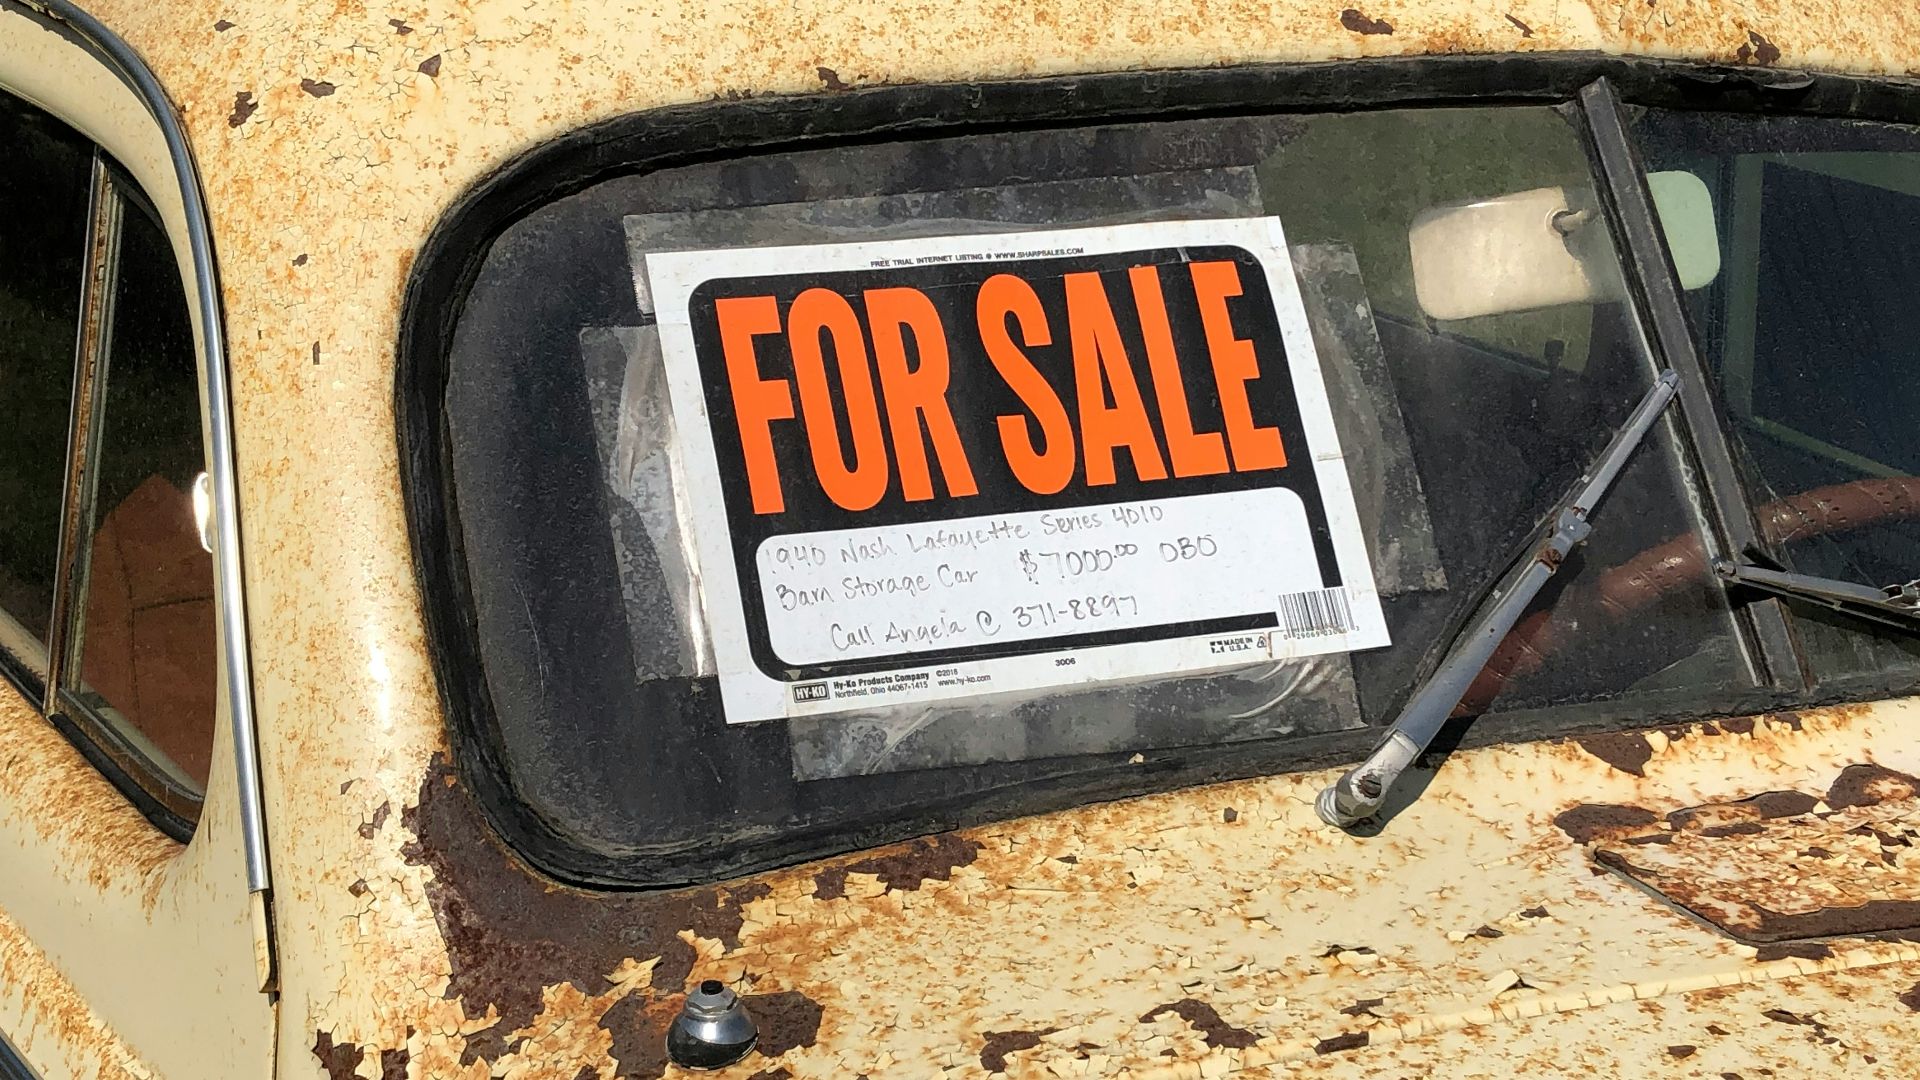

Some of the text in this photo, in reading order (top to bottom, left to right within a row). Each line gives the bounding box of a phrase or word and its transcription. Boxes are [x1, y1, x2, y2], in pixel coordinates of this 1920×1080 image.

[870, 260, 890, 268] FREE
[893, 258, 914, 266] TRIAL
[916, 254, 953, 264] INTERNET
[955, 253, 984, 261] LISTING
[995, 247, 1084, 259] WWW.SHARPSALES.COM
[715, 260, 1287, 514] FOR SALE
[765, 504, 1164, 574] 1940 Nash Lafayette Series 4010
[775, 583, 835, 611] Barn
[841, 574, 931, 600] Storage
[936, 563, 979, 588] Car
[1158, 534, 1218, 563] OBO
[830, 623, 876, 651] Call
[884, 616, 966, 645] Angela
[1012, 594, 1138, 627] 371-8897
[1223, 637, 1244, 646] MADE
[1229, 644, 1252, 652] U.S.A.
[1055, 658, 1076, 667] 3006
[833, 672, 929, 690] Hy-Ko Products Company
[937, 674, 991, 686] www.hy-ko.com
[794, 685, 827, 700] HY-KO
[834, 688, 870, 699] Northfield,
[870, 686, 886, 695] Ohio
